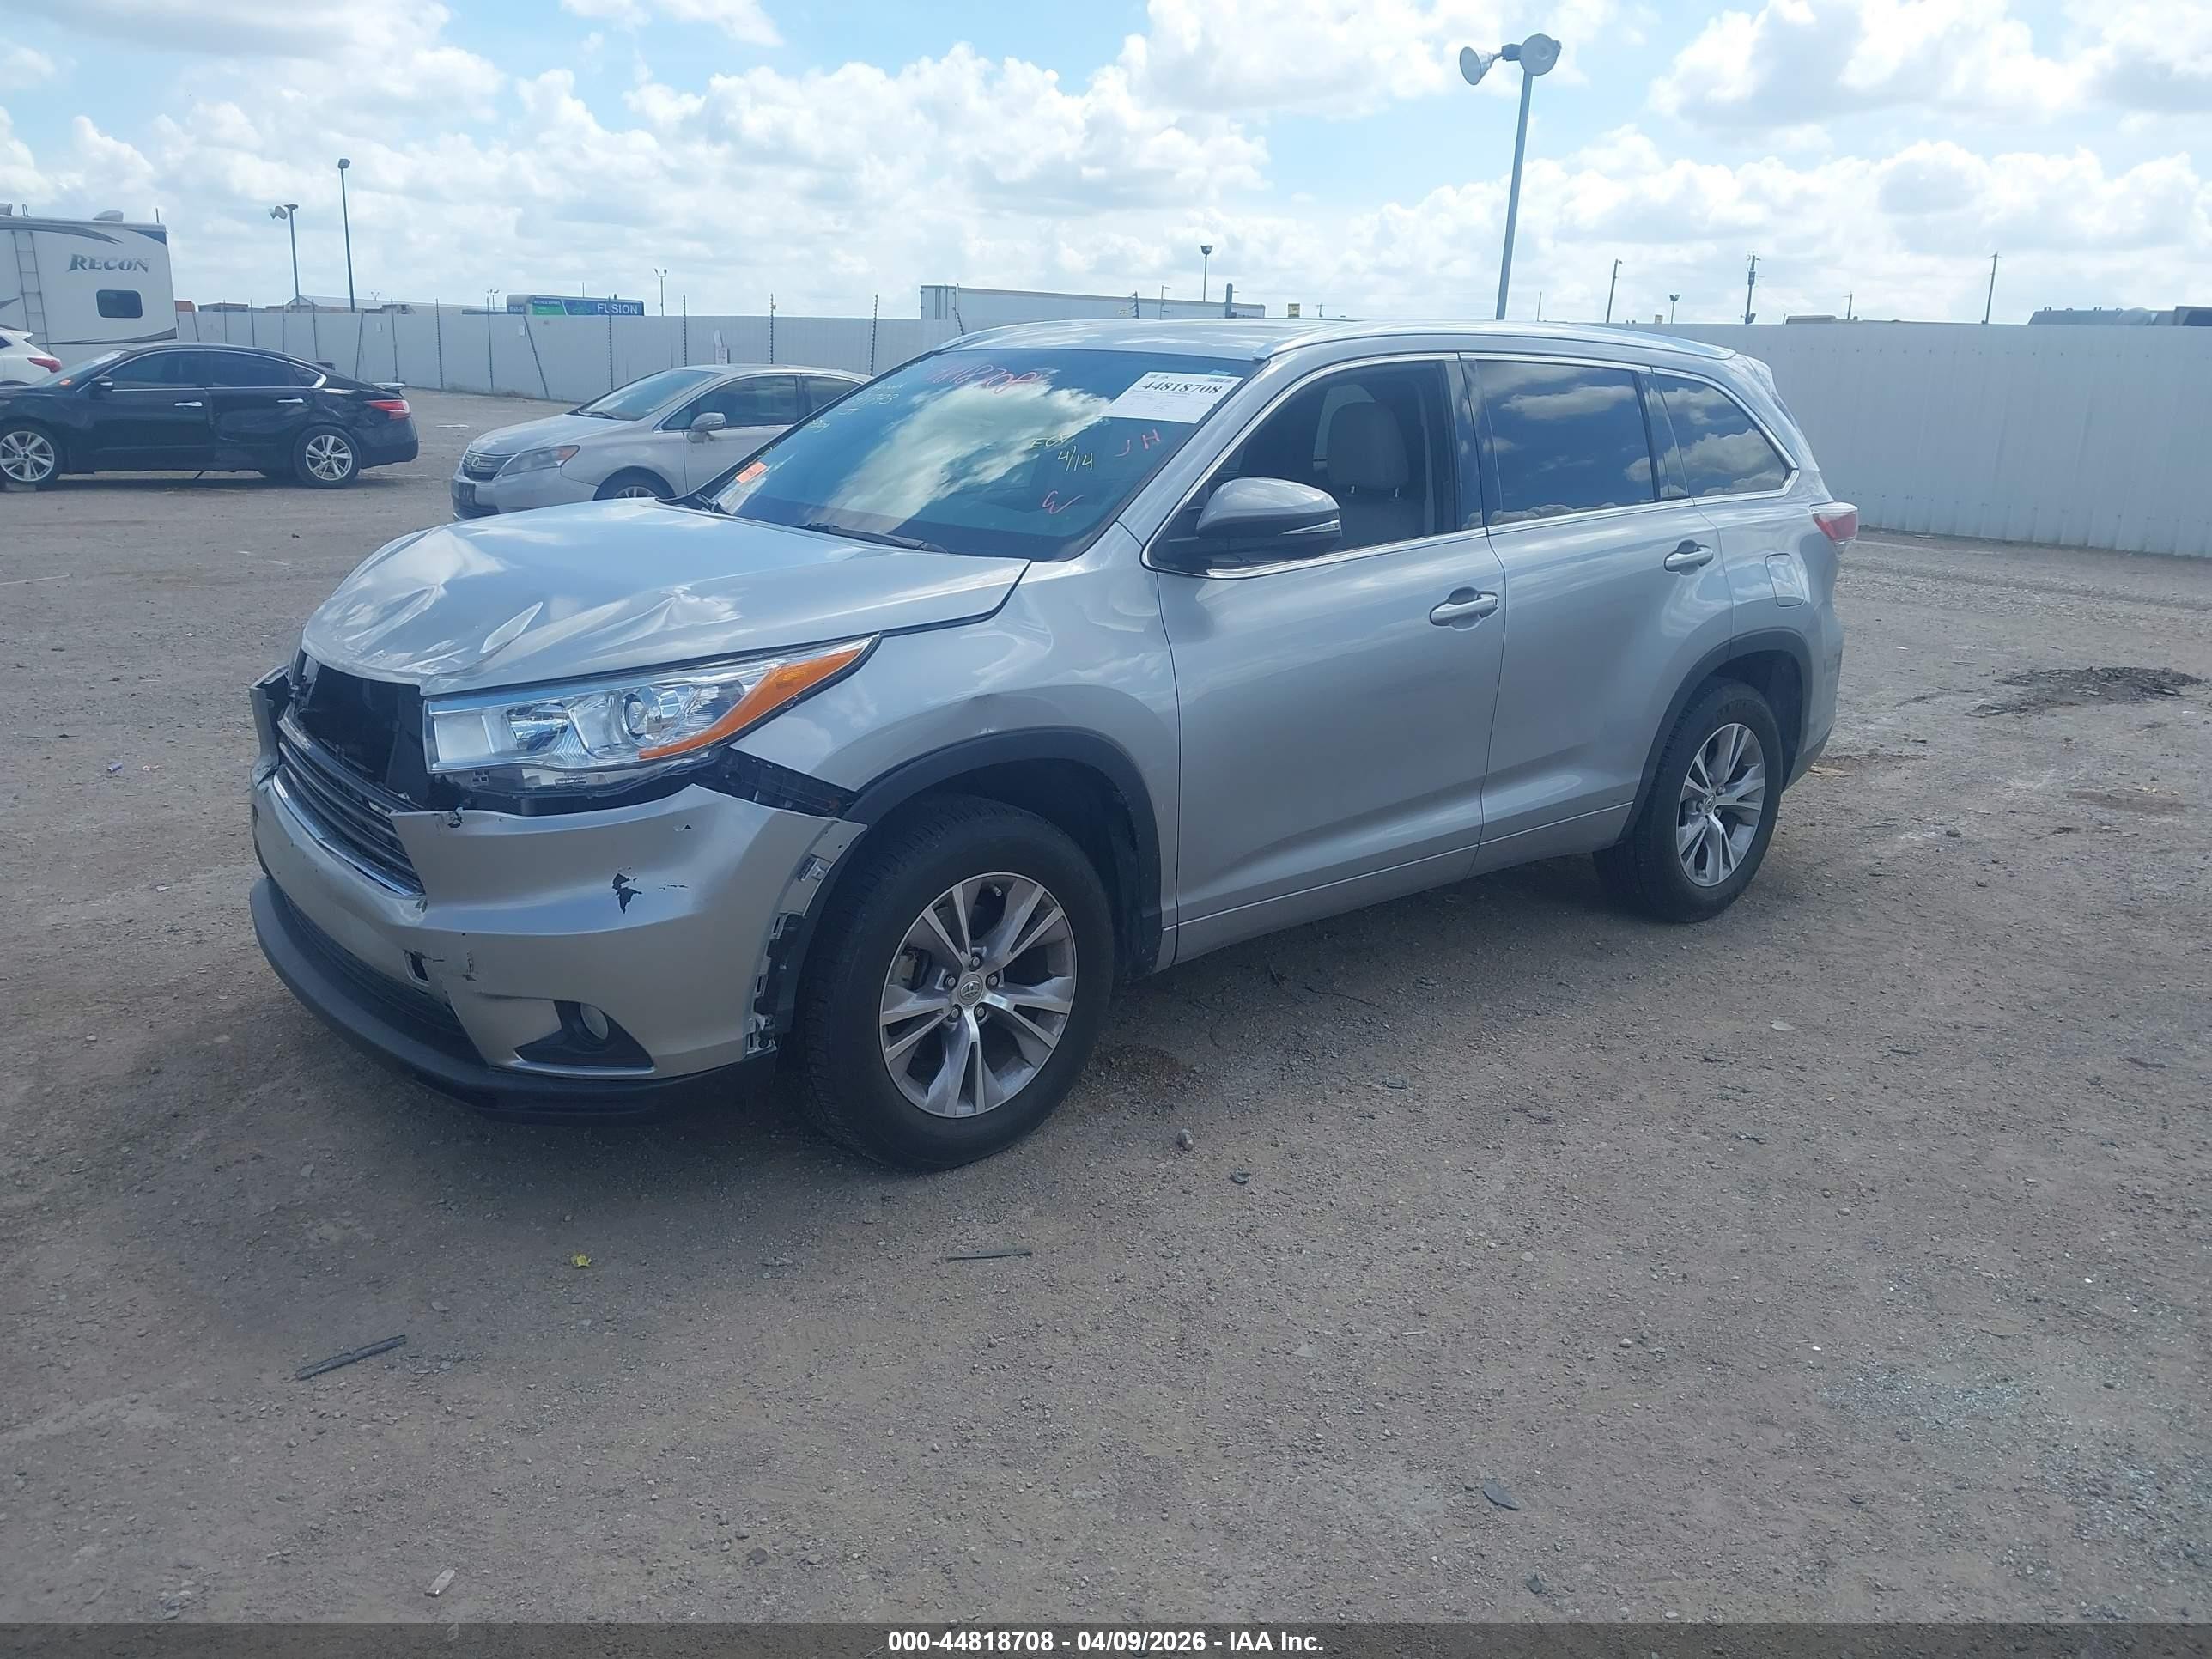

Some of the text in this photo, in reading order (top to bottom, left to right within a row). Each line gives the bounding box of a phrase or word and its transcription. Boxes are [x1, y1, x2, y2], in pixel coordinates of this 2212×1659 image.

[67, 253, 151, 273] RECON
[597, 302, 638, 315] FUSION
[1142, 381, 1223, 395] 44818708
[1057, 445, 1094, 472] 4/14
